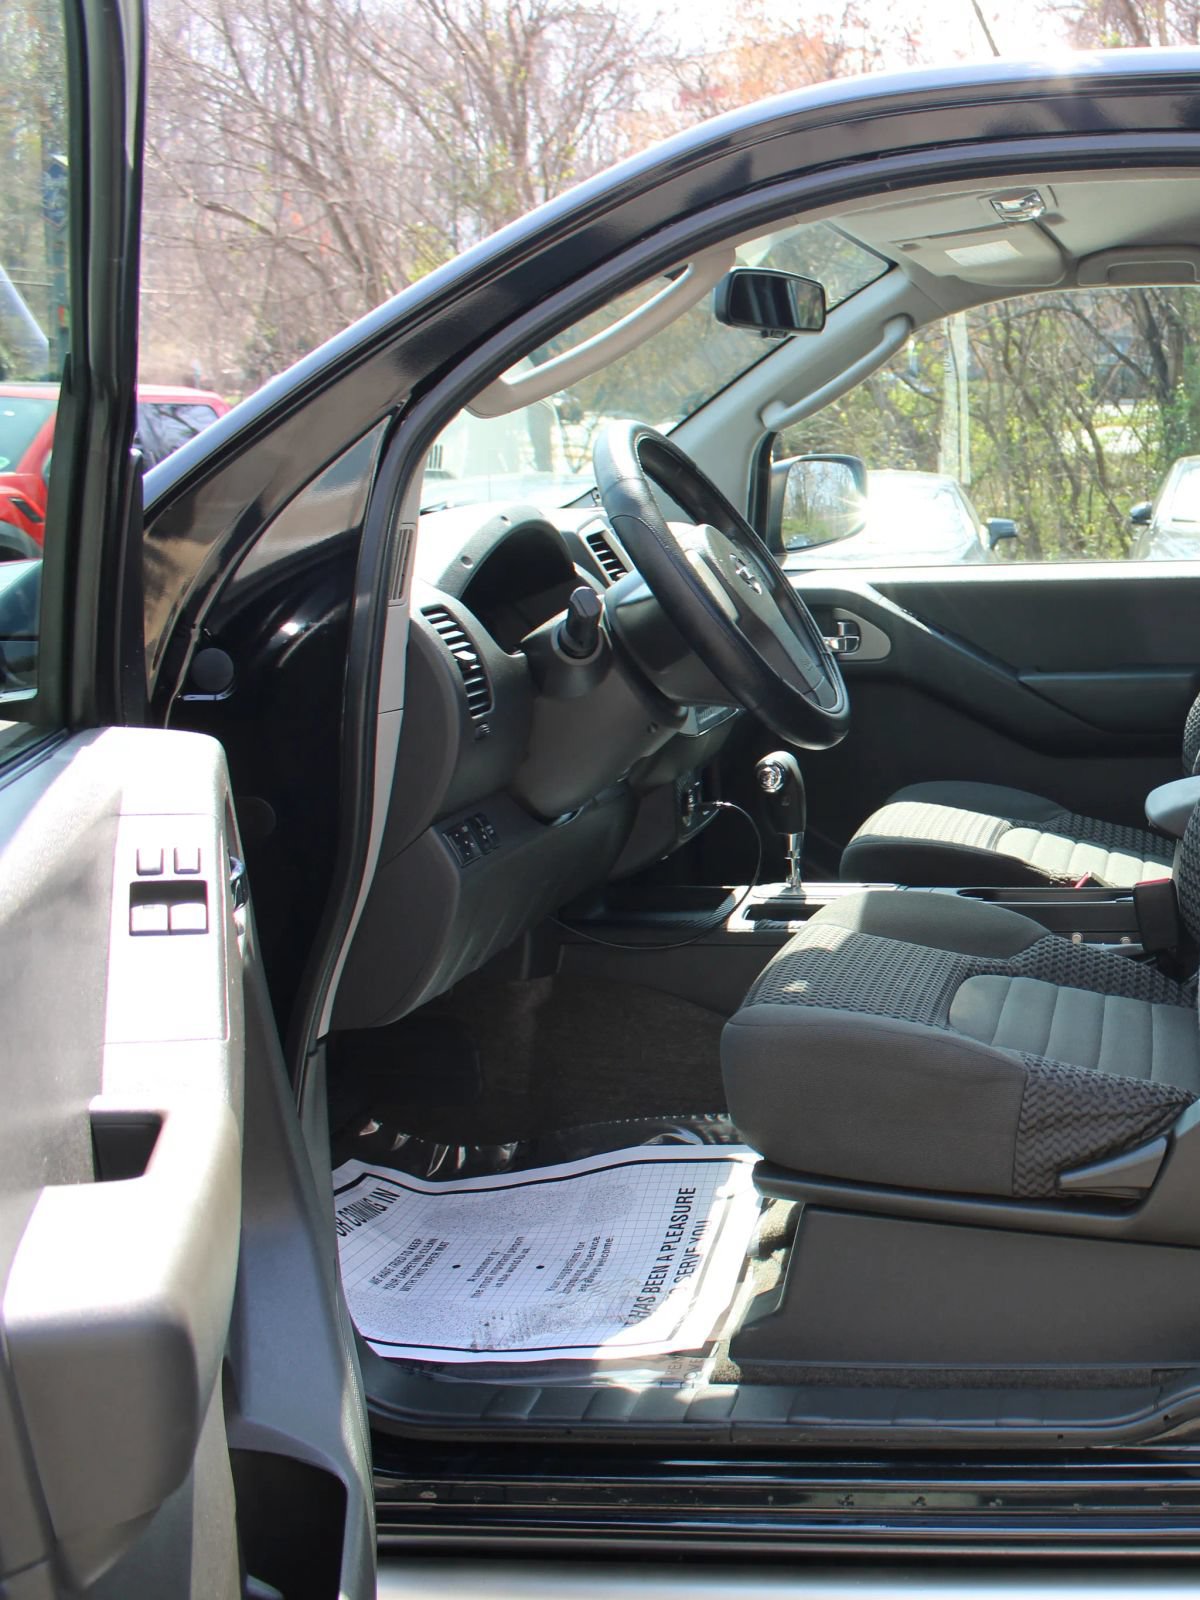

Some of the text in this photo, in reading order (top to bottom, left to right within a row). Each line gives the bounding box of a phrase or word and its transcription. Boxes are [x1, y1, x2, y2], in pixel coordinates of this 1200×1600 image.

[336, 1187, 400, 1237] OR COMING IN
[661, 1187, 696, 1251] PLEASURE
[388, 1255, 407, 1268] TRIED
[408, 1238, 422, 1251] KEEP
[490, 1253, 514, 1275] important
[506, 1236, 526, 1254] person
[573, 1241, 585, 1251] for
[585, 1236, 601, 1261] service
[382, 1238, 439, 1290] YOUR CARPETING CLEAN
[400, 1278, 417, 1292] WITH
[411, 1265, 428, 1280] THIS
[420, 1250, 441, 1268] PAPER
[471, 1256, 496, 1278] customer
[641, 1264, 671, 1293] BEEN
[628, 1296, 656, 1320] HAS
